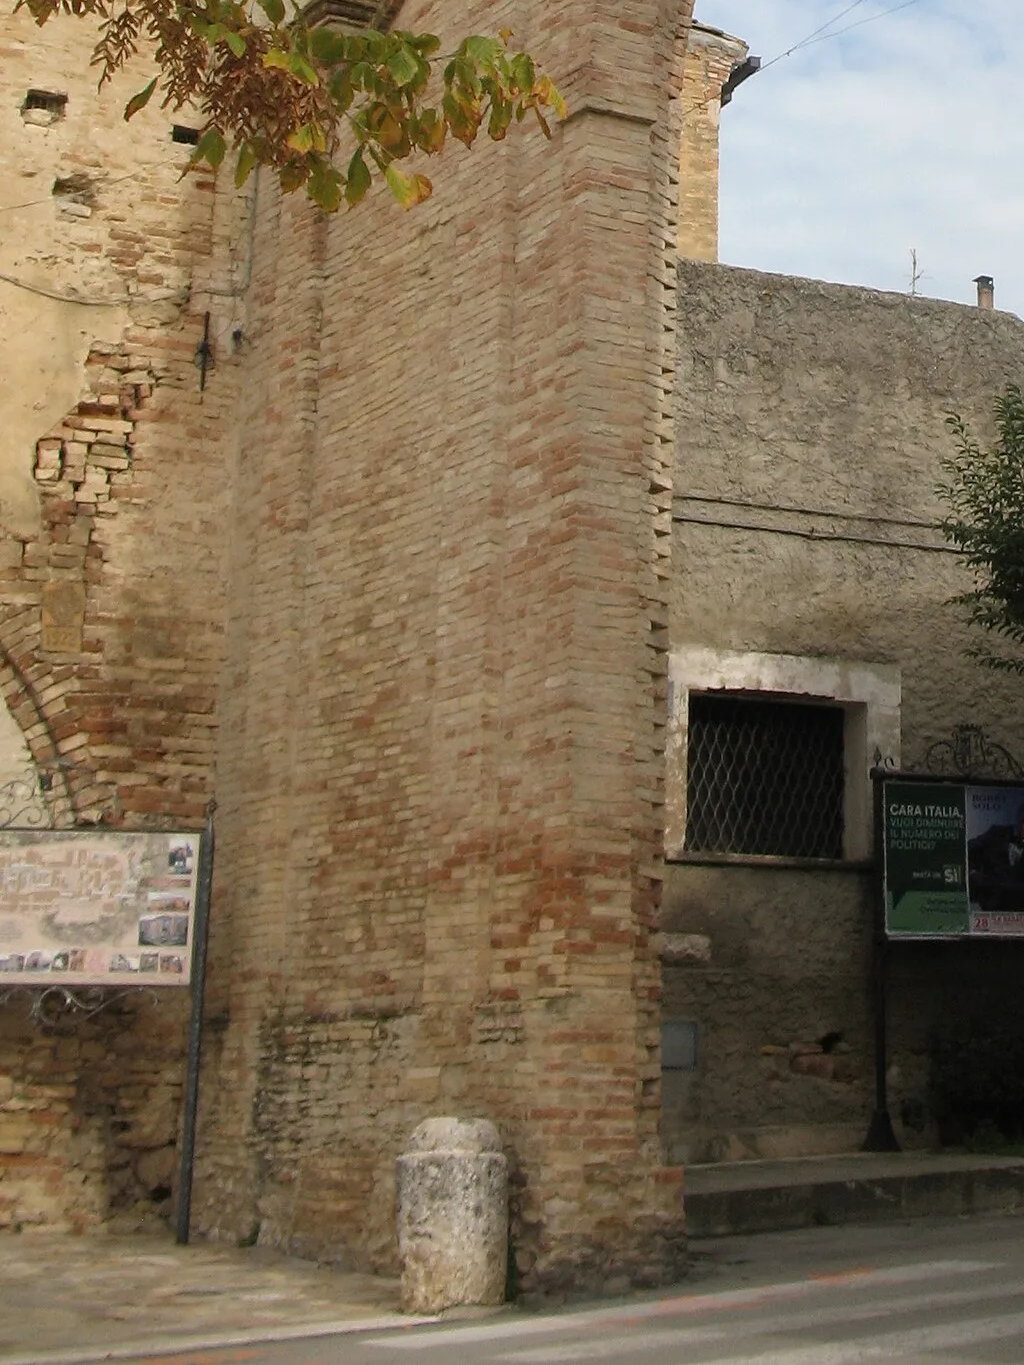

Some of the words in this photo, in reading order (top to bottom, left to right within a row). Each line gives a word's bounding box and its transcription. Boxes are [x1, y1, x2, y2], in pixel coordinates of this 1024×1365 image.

[889, 803, 922, 816] CARA
[901, 829, 942, 839] NUMERO
[975, 916, 989, 927] 28
